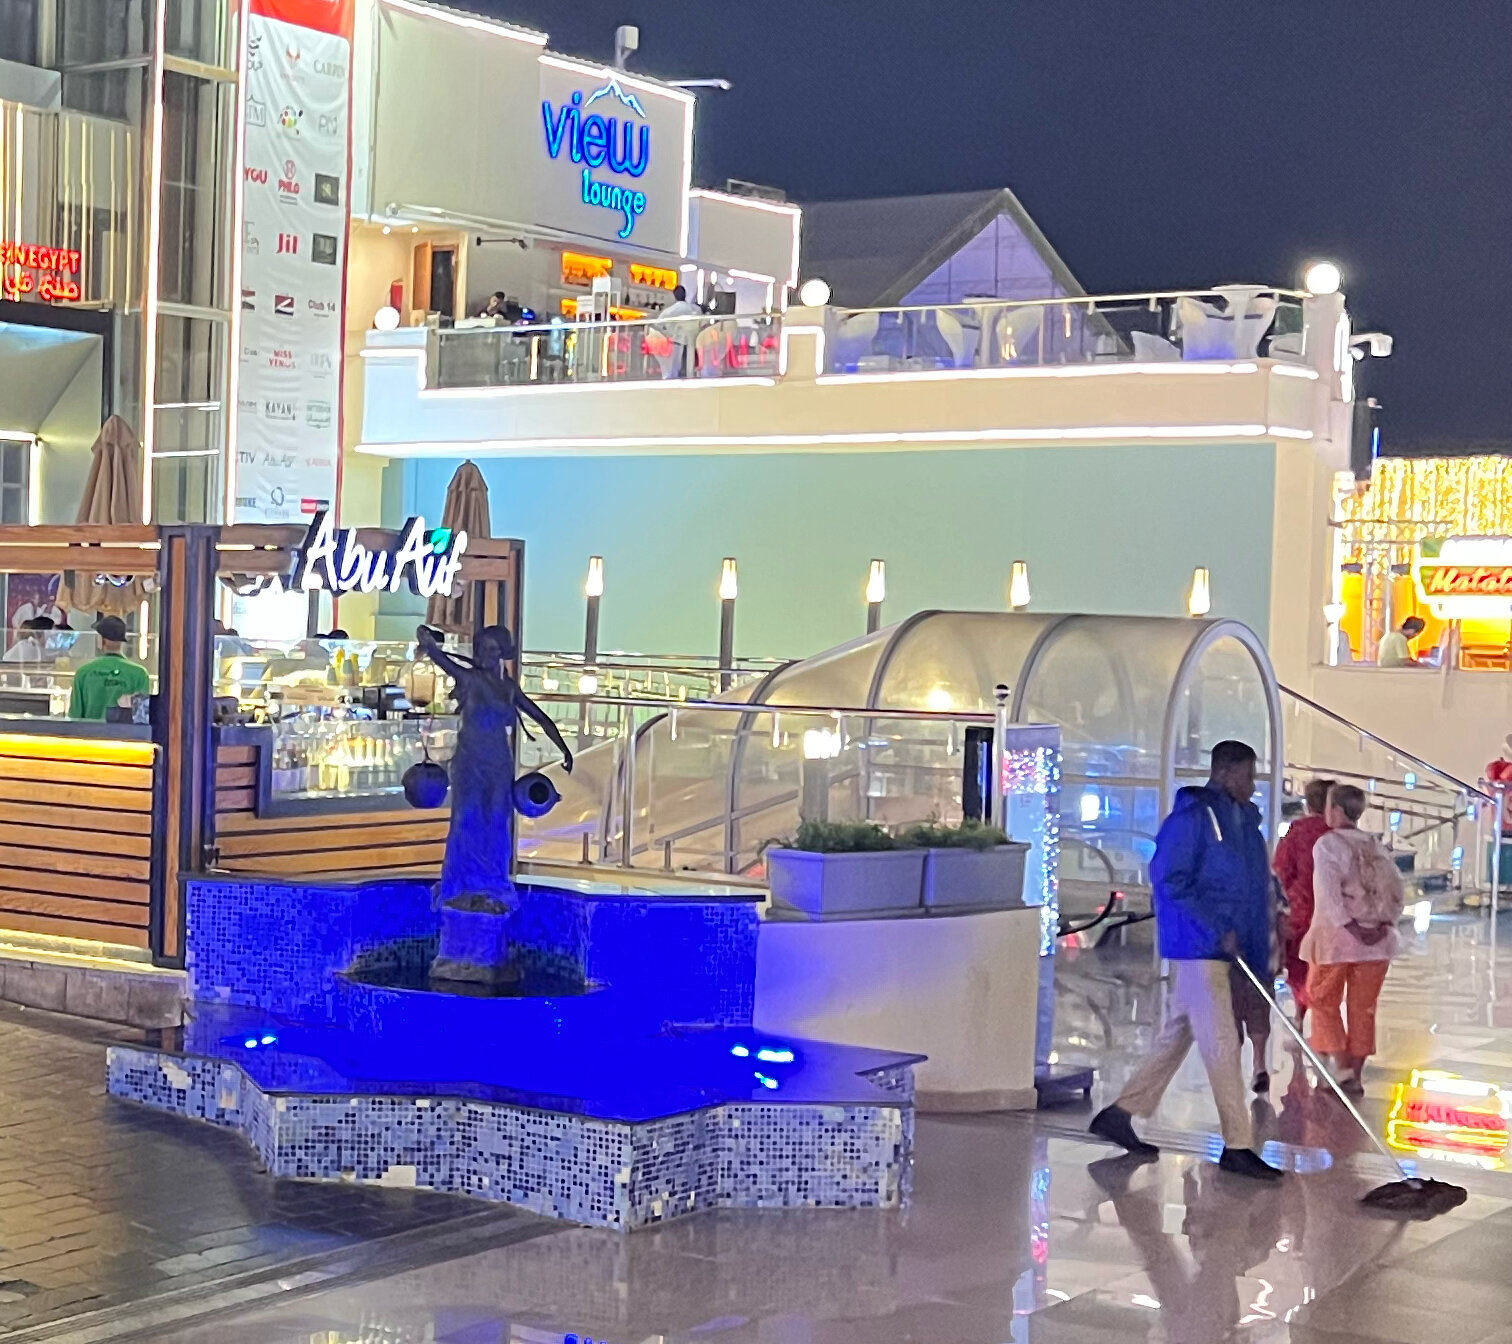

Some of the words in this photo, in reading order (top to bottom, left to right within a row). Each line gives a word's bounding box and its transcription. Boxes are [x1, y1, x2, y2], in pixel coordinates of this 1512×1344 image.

[542, 91, 649, 177] view
[582, 168, 646, 238] lounge
[27, 245, 81, 274] EGYPT
[38, 274, 81, 301] صنع
[300, 510, 390, 594] Abu
[390, 516, 469, 598] Auf
